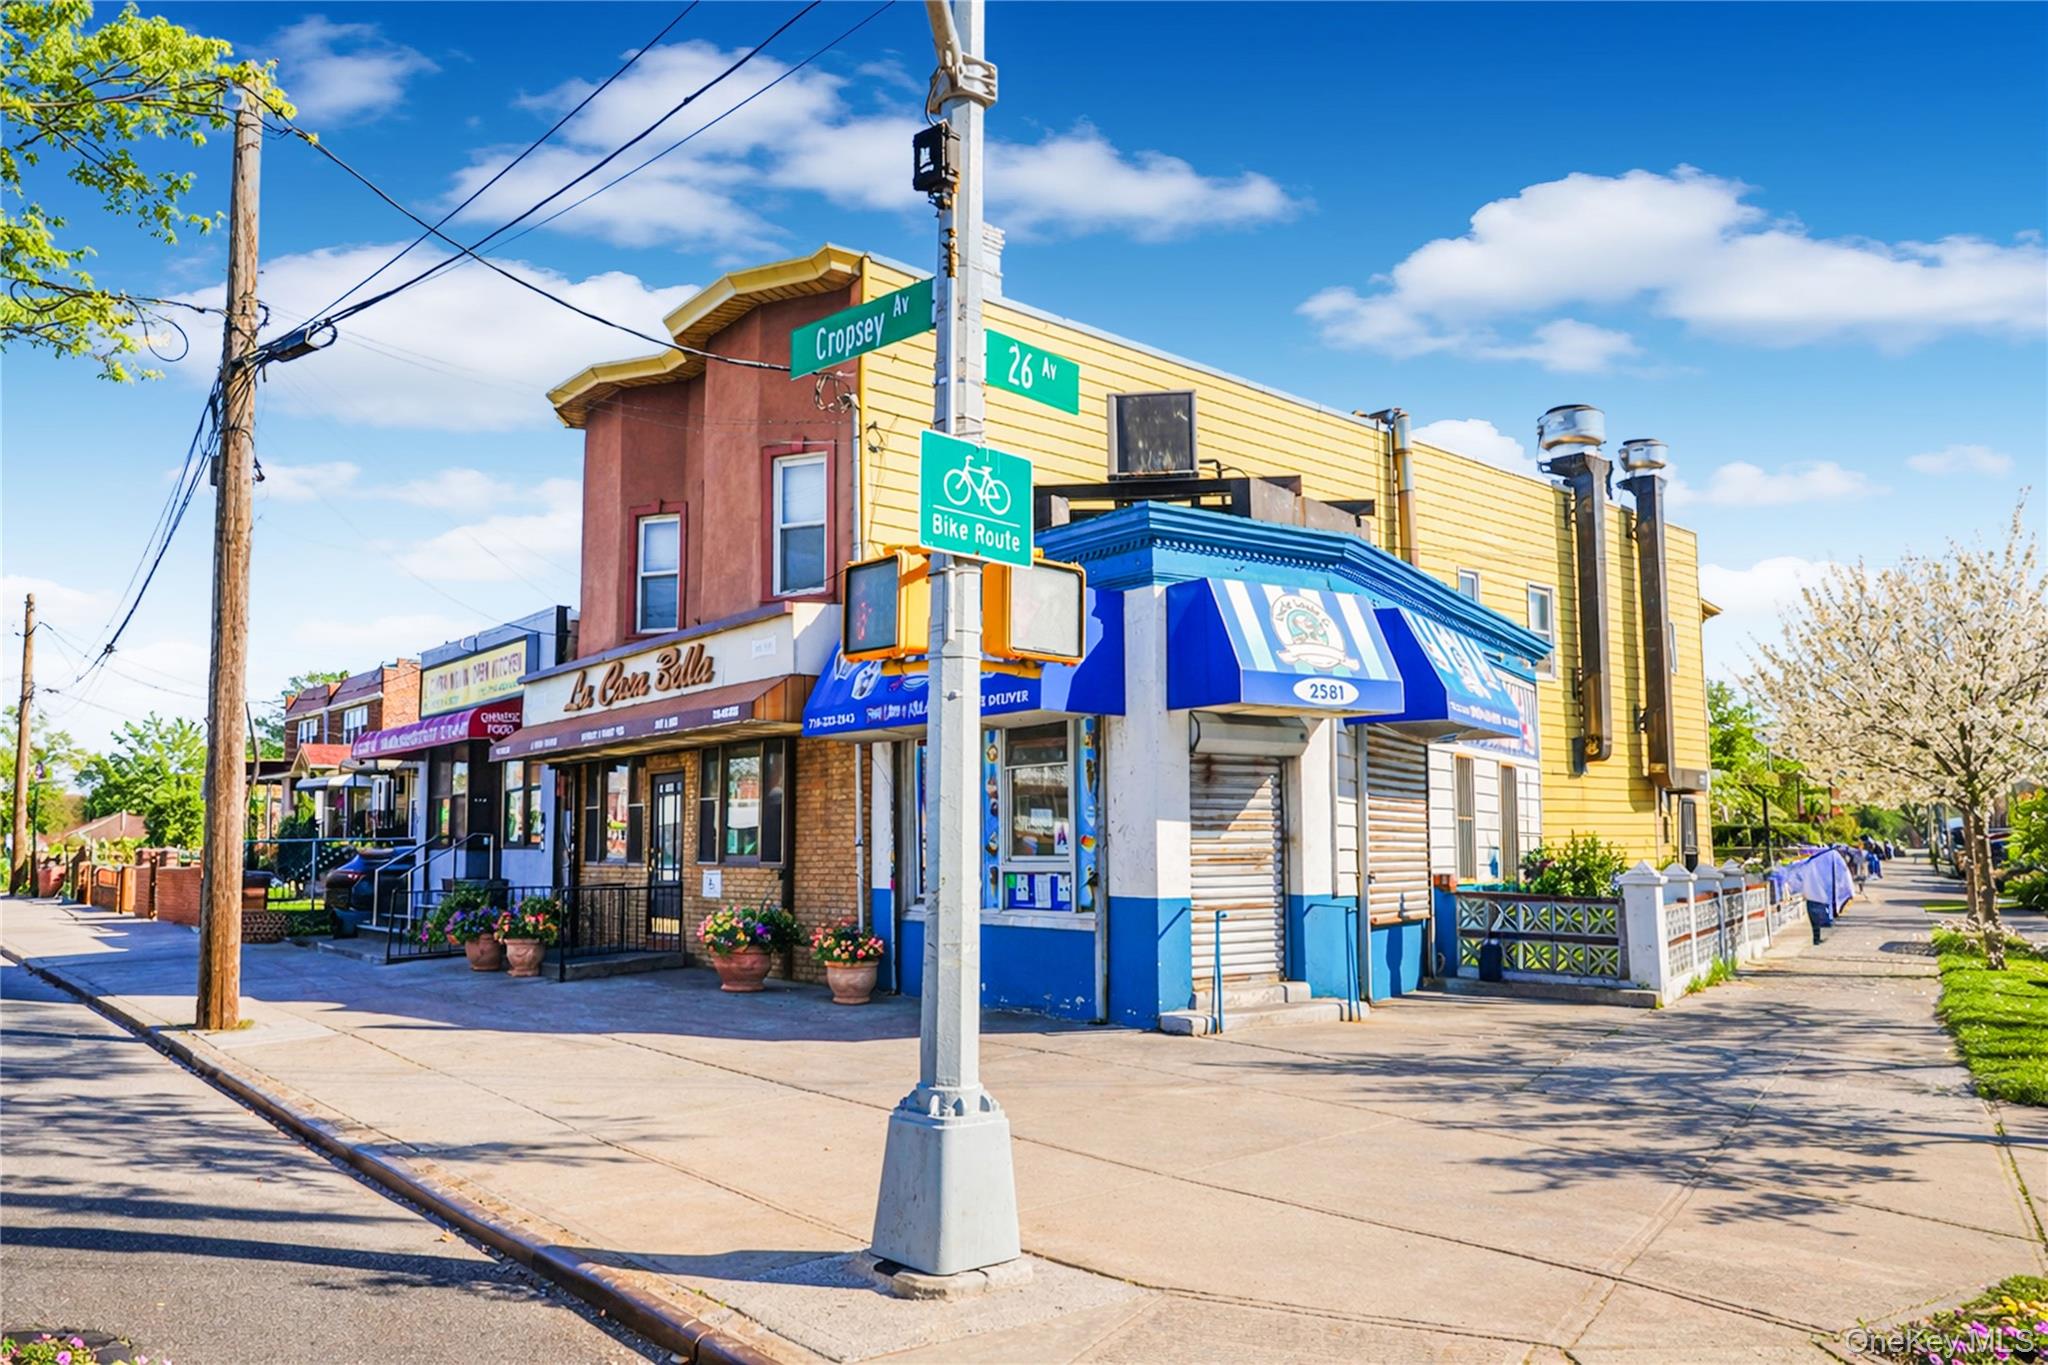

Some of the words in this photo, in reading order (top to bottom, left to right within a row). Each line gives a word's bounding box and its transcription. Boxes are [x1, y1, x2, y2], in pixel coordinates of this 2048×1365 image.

[816, 311, 885, 361] Cropsey
[893, 294, 909, 318] Av
[1008, 342, 1034, 389] 26
[1042, 356, 1057, 381] Av
[932, 512, 969, 541] Bike
[975, 522, 1021, 553] Route
[564, 669, 595, 712] La
[598, 661, 651, 706] Casa
[654, 643, 715, 692] Bella
[1309, 682, 1345, 700] 2581
[487, 724, 514, 735] FOOD
